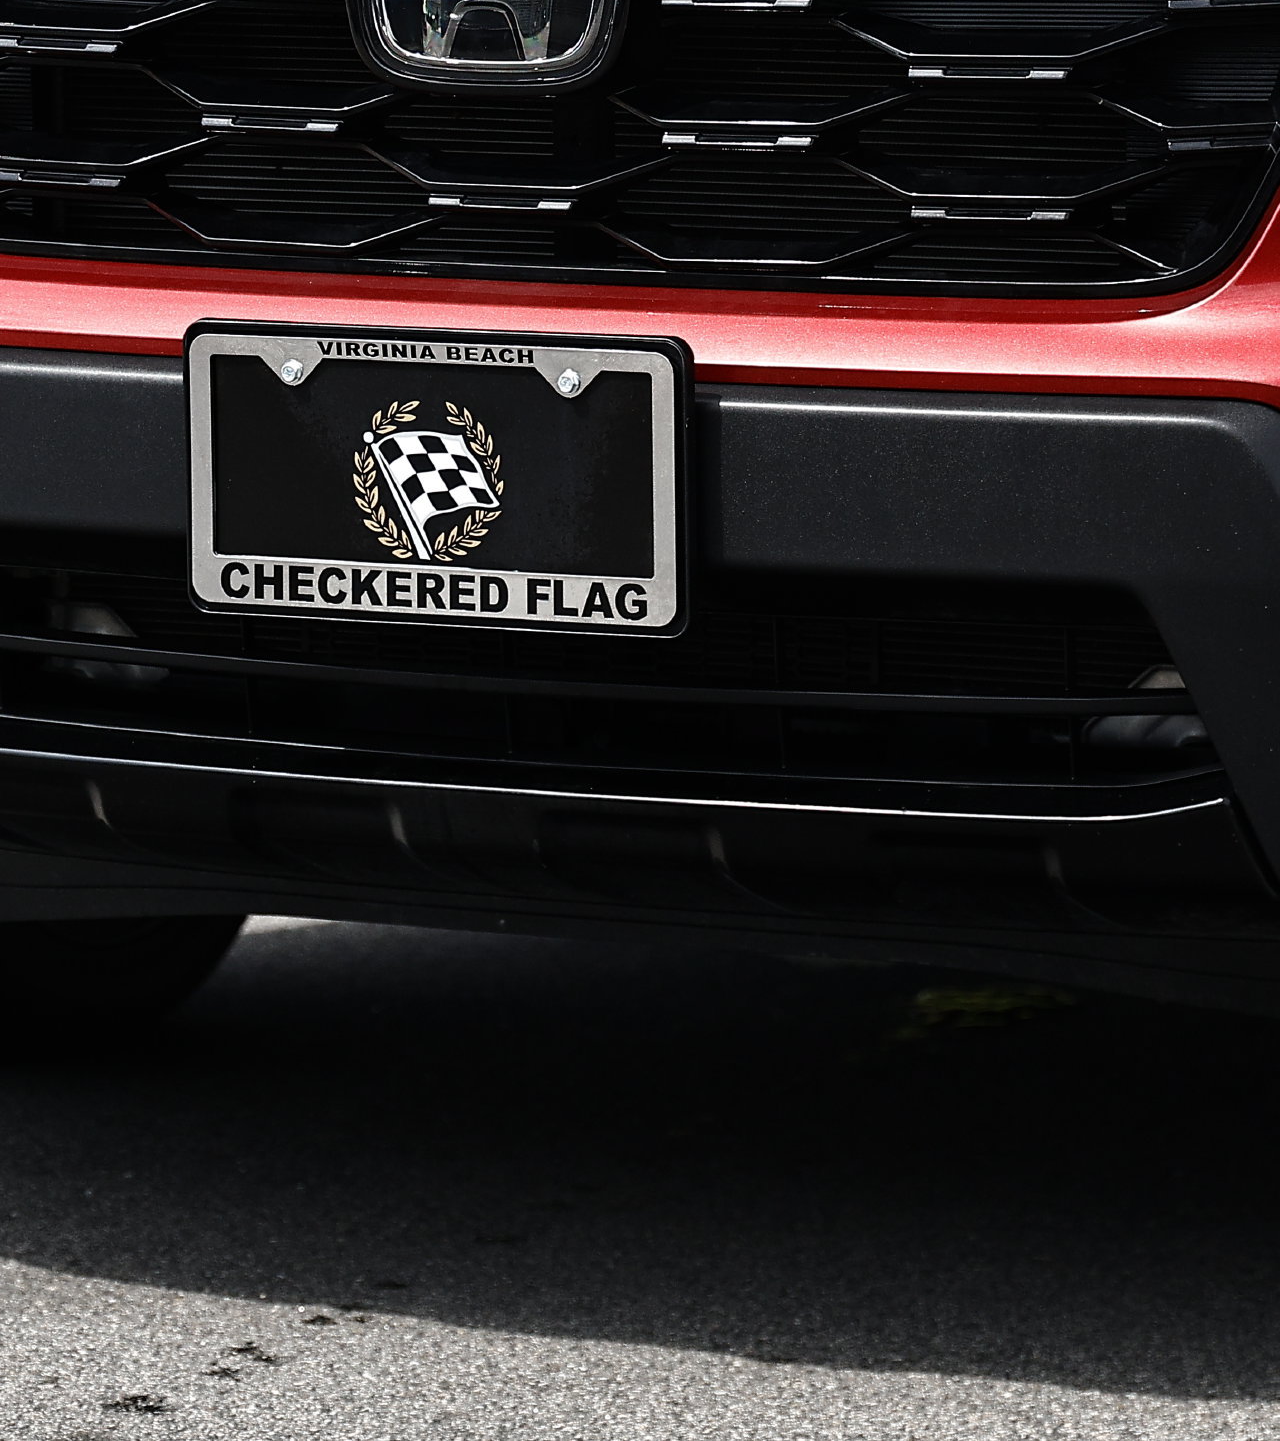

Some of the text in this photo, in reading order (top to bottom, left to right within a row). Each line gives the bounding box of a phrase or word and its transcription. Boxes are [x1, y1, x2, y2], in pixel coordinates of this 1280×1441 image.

[317, 341, 535, 364] VIRGINIA BEACH
[220, 562, 649, 621] CHECKERED FLAG
